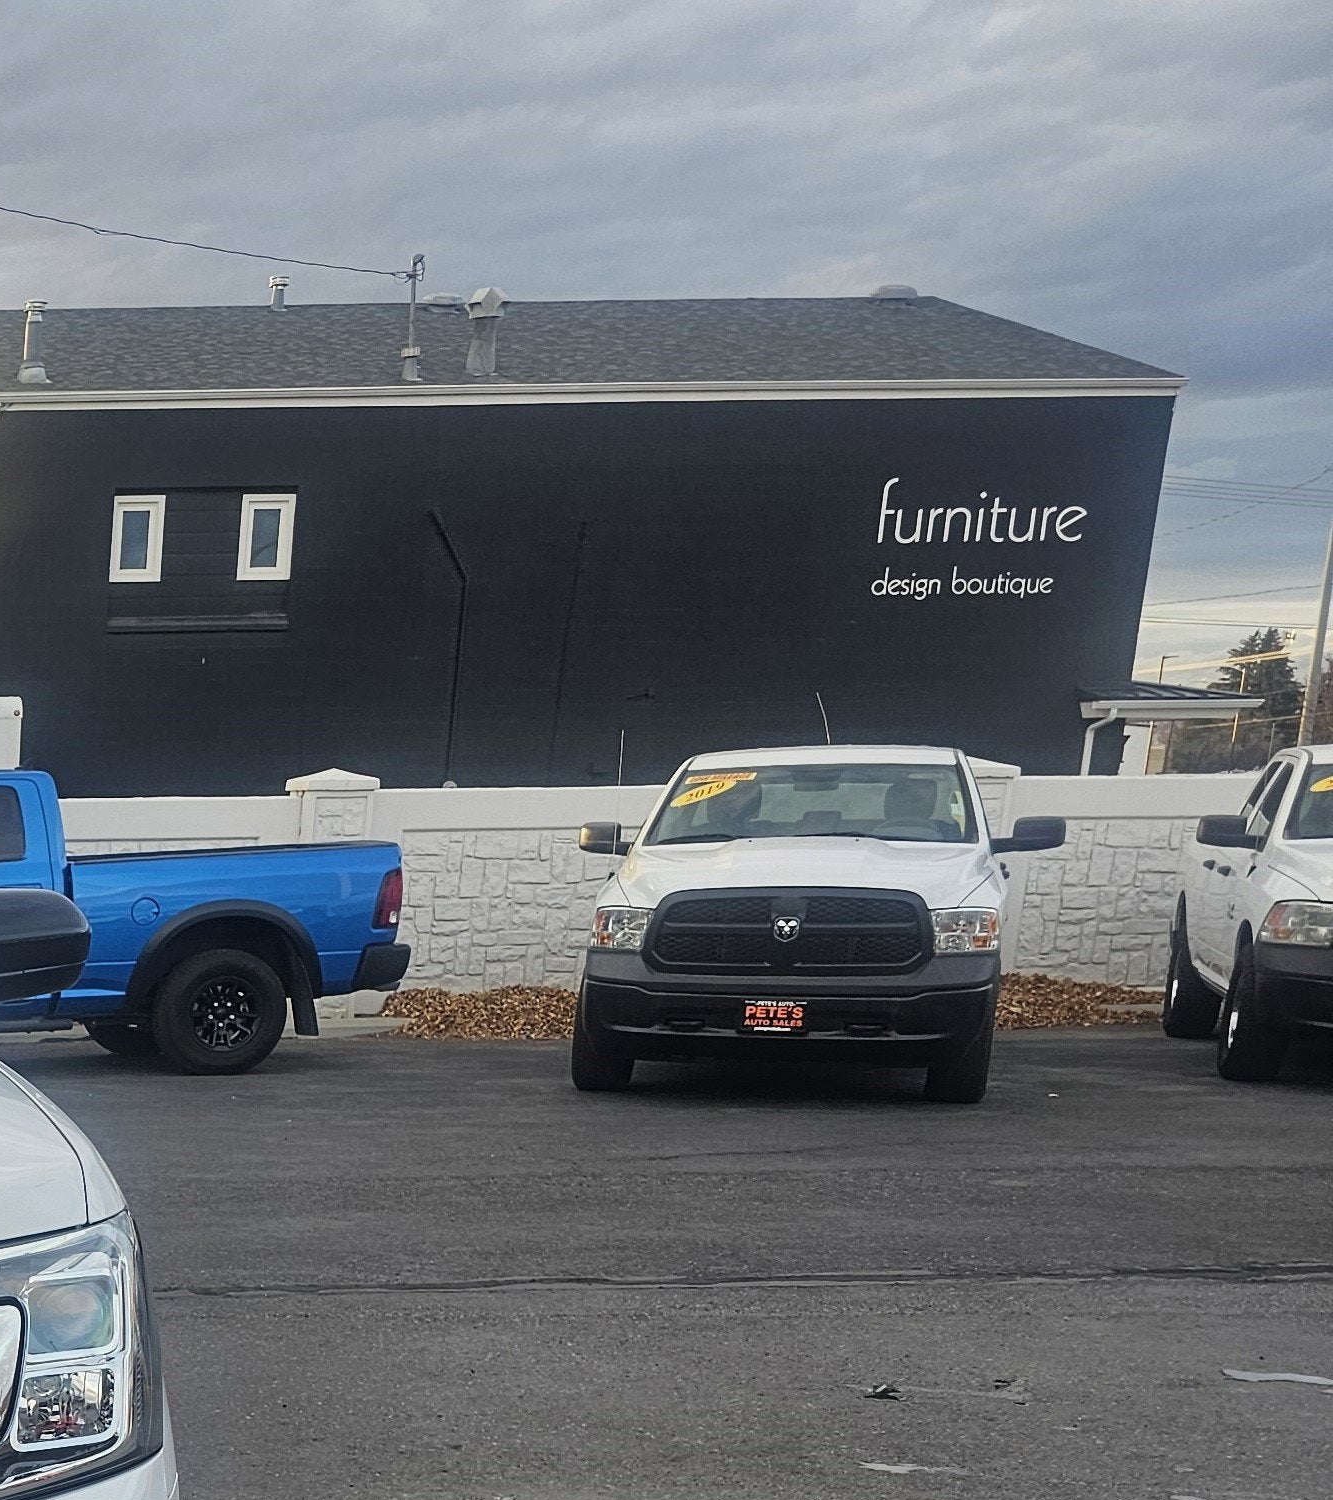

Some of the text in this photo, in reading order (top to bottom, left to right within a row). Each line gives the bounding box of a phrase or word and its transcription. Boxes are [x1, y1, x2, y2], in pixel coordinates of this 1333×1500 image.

[878, 478, 1087, 543] furniture
[871, 566, 1053, 600] design boutique
[686, 782, 726, 802] 2019
[745, 1006, 803, 1018] PETE'S
